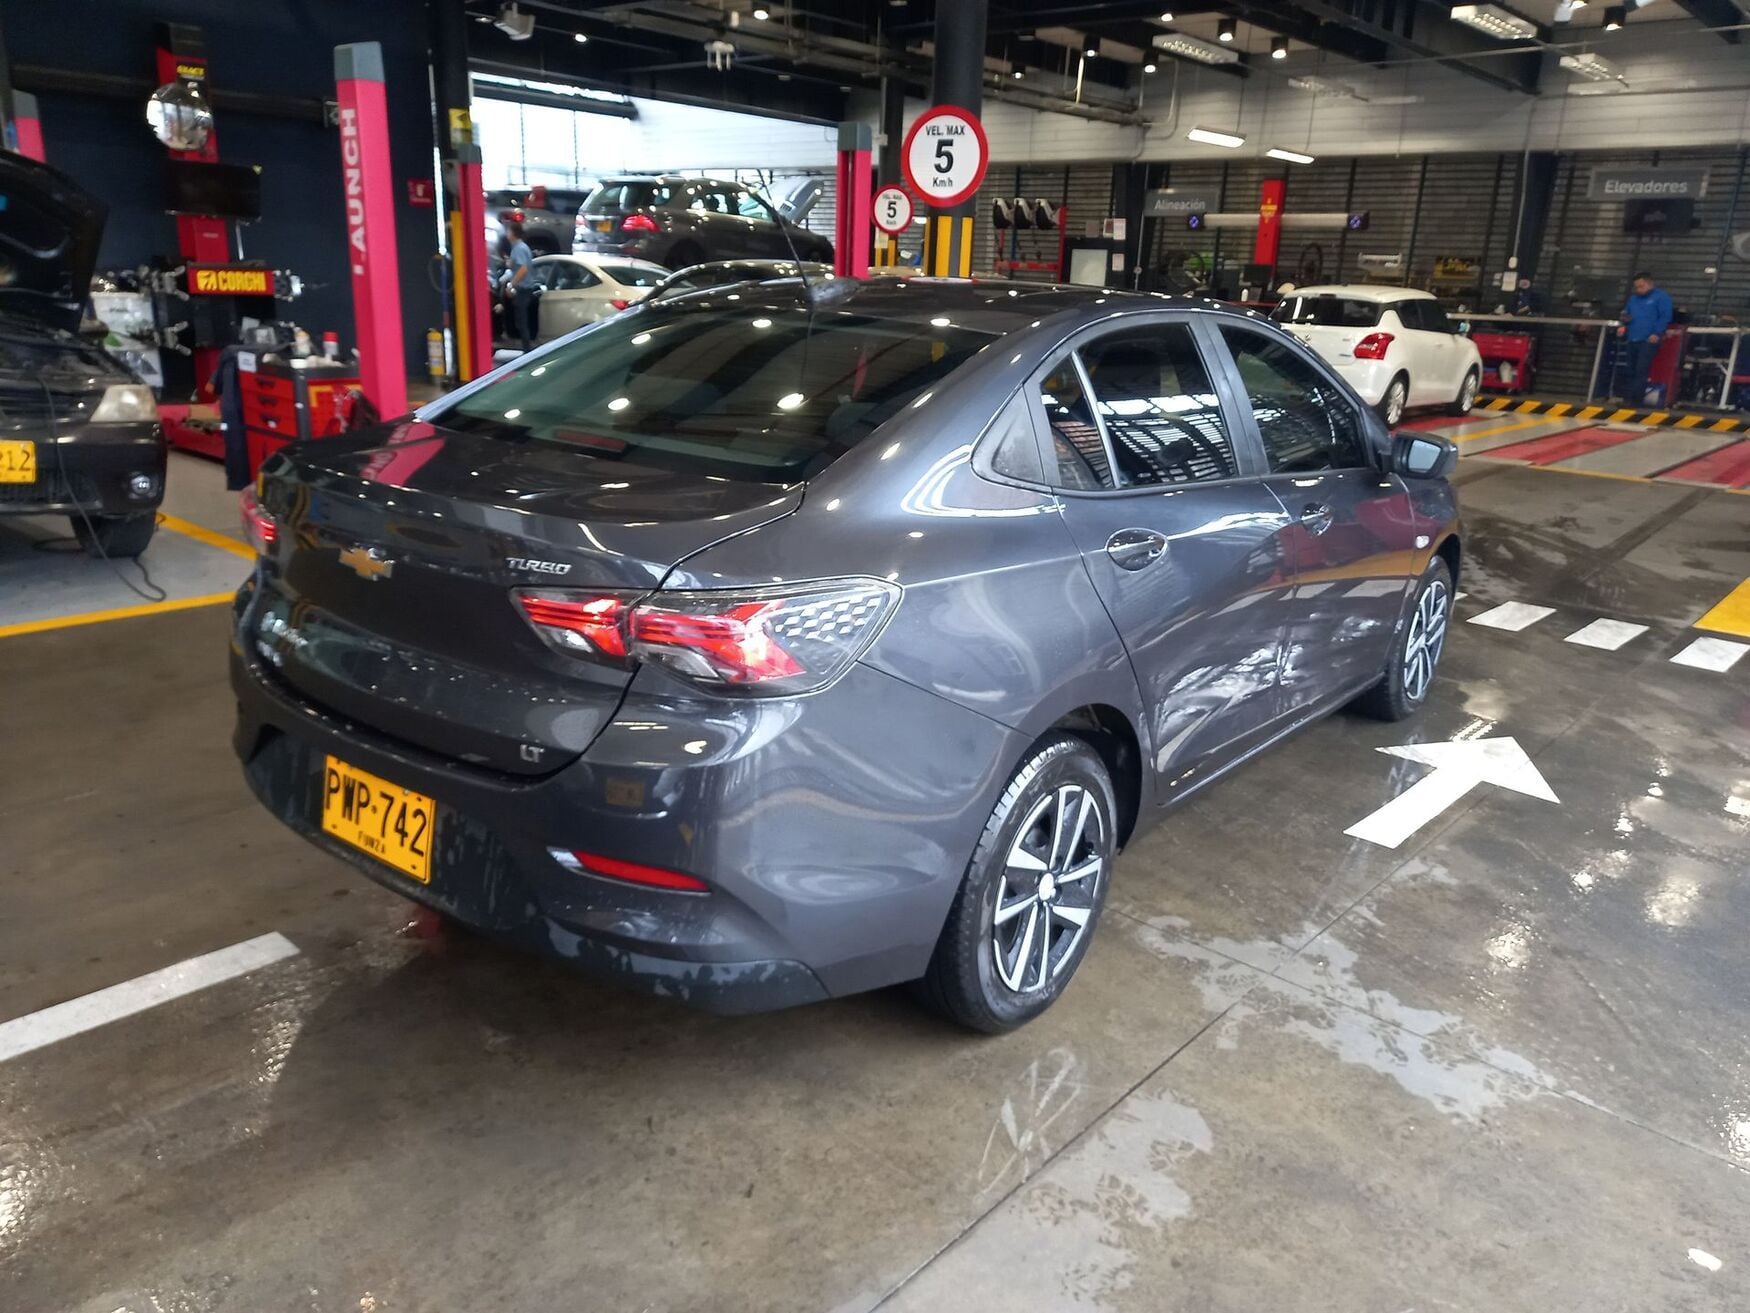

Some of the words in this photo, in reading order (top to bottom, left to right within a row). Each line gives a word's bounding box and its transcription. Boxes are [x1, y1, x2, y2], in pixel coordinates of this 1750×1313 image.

[946, 125, 966, 136] MAX
[934, 138, 954, 173] 5
[1604, 180, 1688, 194] Elevadores
[887, 200, 897, 218] 5
[1154, 198, 1206, 210] Alineación
[505, 557, 572, 575] TURBO
[520, 744, 545, 763] LT
